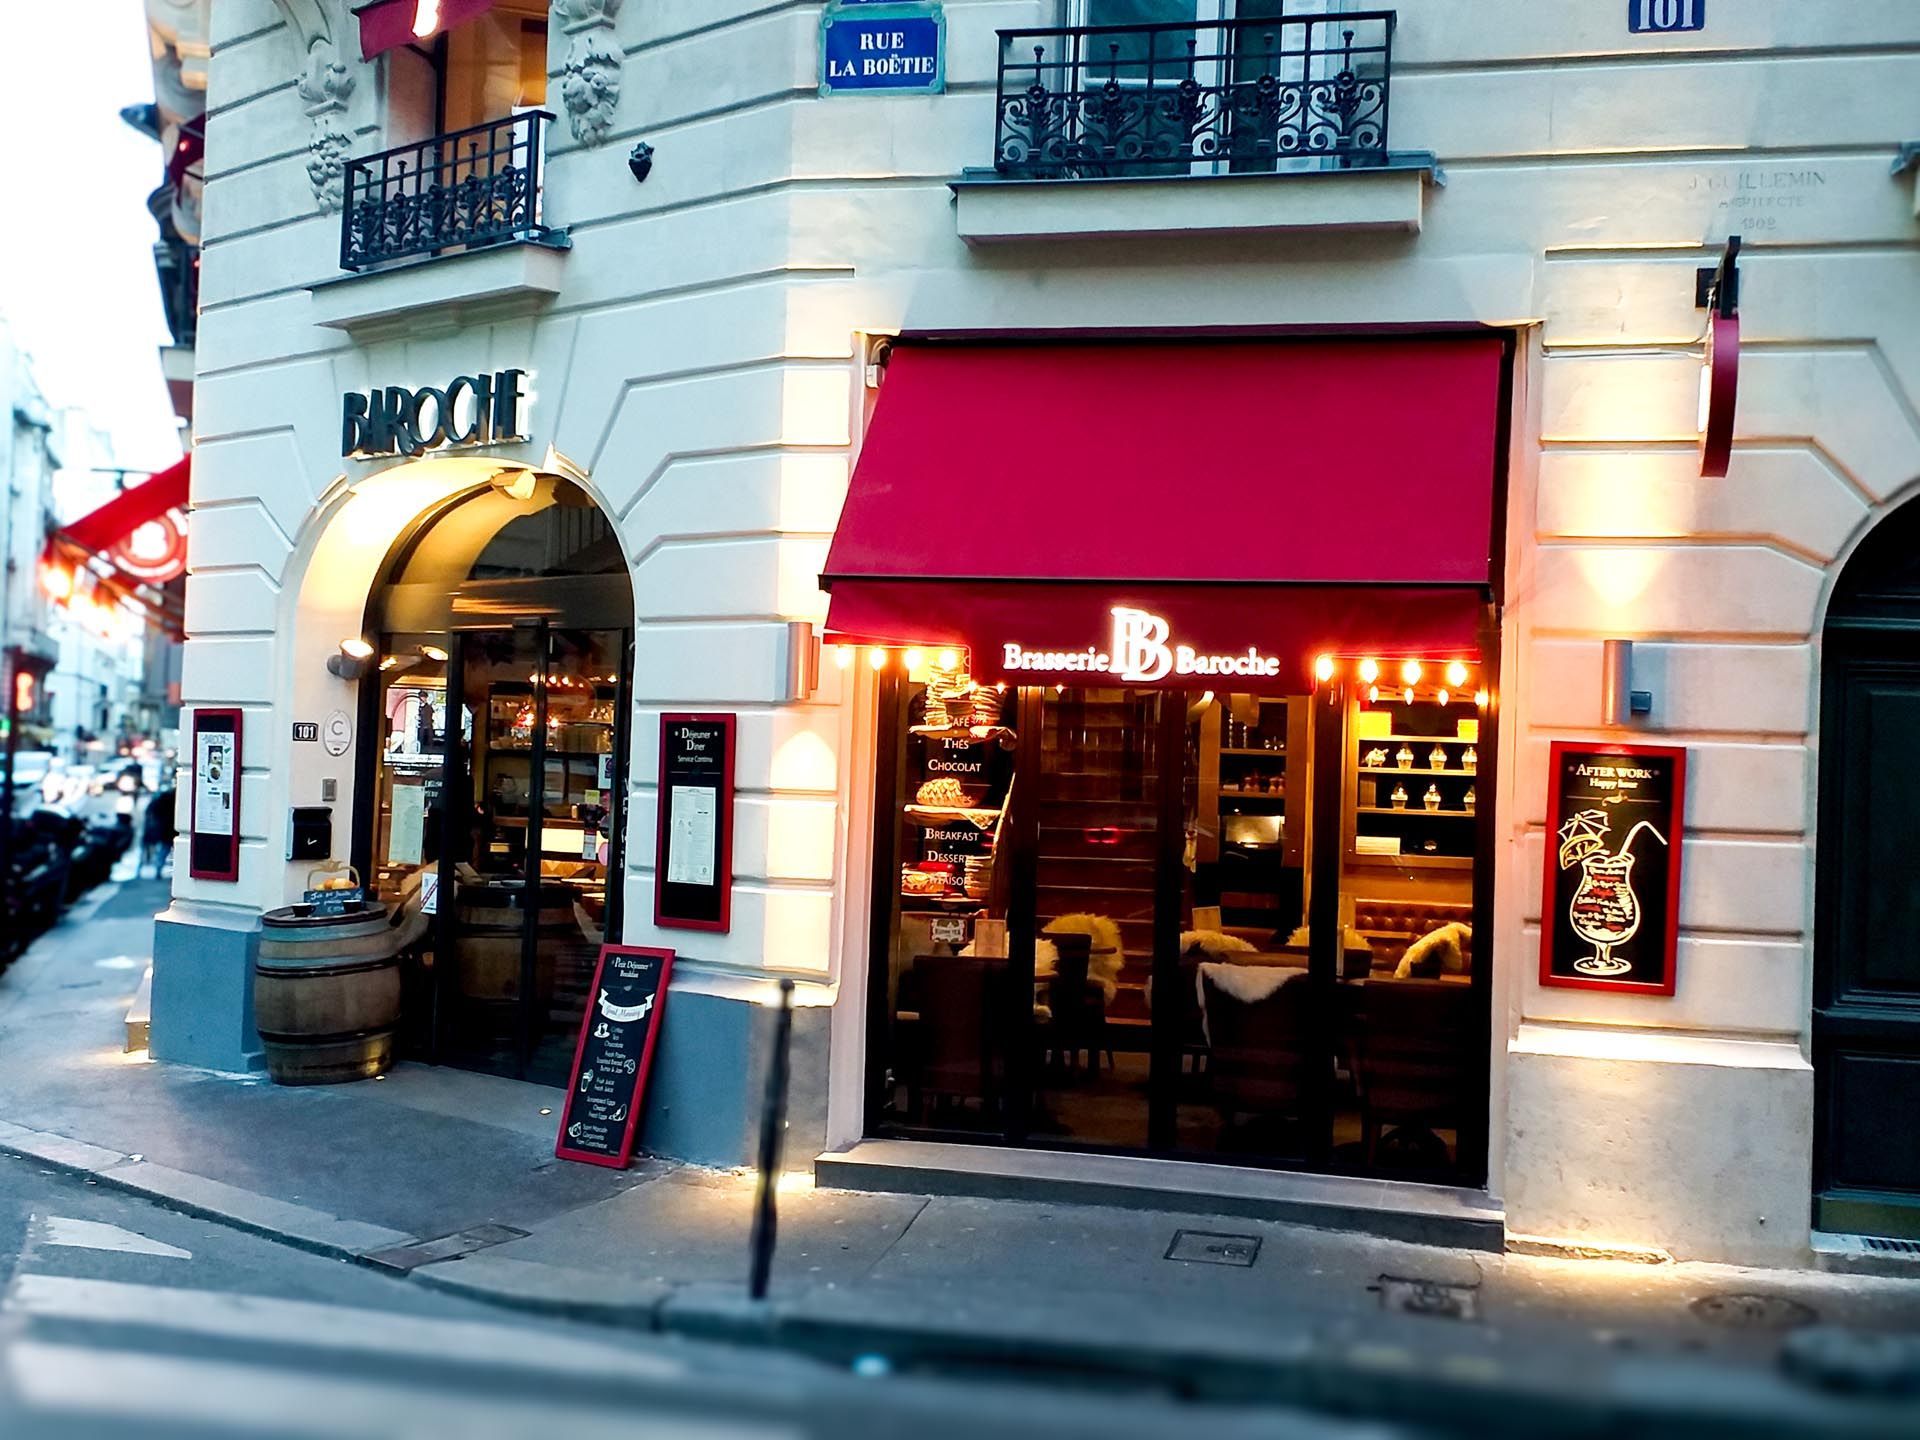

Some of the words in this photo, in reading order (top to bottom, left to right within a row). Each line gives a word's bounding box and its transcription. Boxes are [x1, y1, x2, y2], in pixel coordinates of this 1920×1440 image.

[1638, 0, 1694, 30] 101
[860, 32, 904, 50] RUE
[829, 60, 857, 77] LA
[863, 53, 935, 76] BOËTIE
[342, 369, 537, 457] BAROCHE
[1003, 643, 1110, 673] Brasserie
[1175, 646, 1280, 676] Baroche
[298, 726, 315, 739] 101
[928, 759, 982, 772] CHOCOLAT
[1576, 763, 1616, 778] AFTER
[1615, 767, 1653, 779] WORK
[925, 827, 980, 842] BREAKFAST
